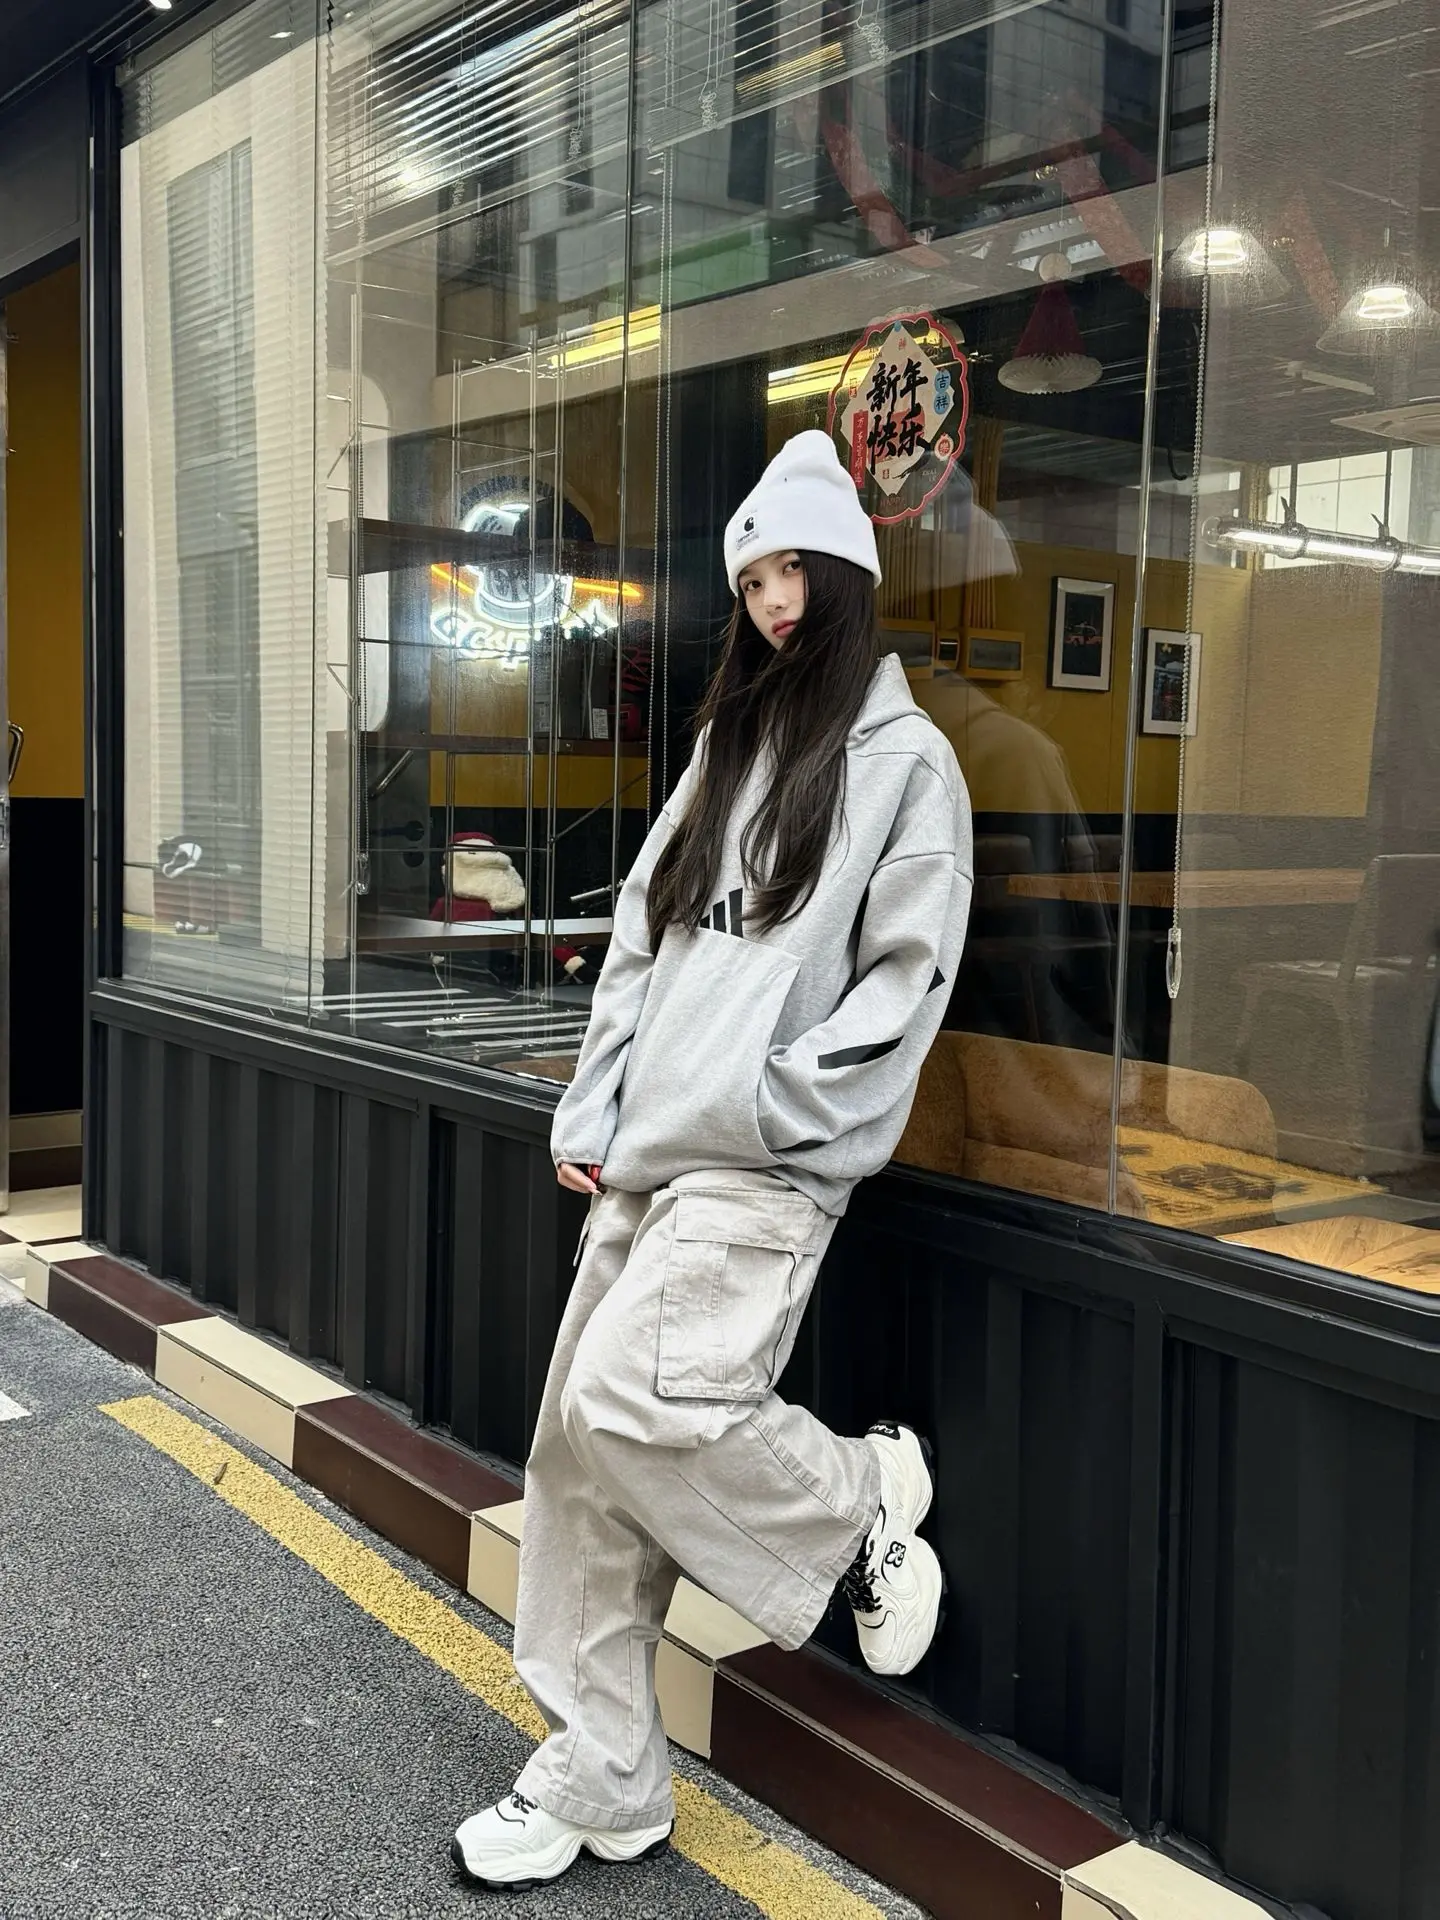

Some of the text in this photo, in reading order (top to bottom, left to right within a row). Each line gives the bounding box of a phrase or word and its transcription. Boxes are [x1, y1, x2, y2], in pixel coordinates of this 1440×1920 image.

[866, 358, 929, 414] 新年
[936, 373, 949, 410] 吉祥
[867, 406, 931, 476] 快乐
